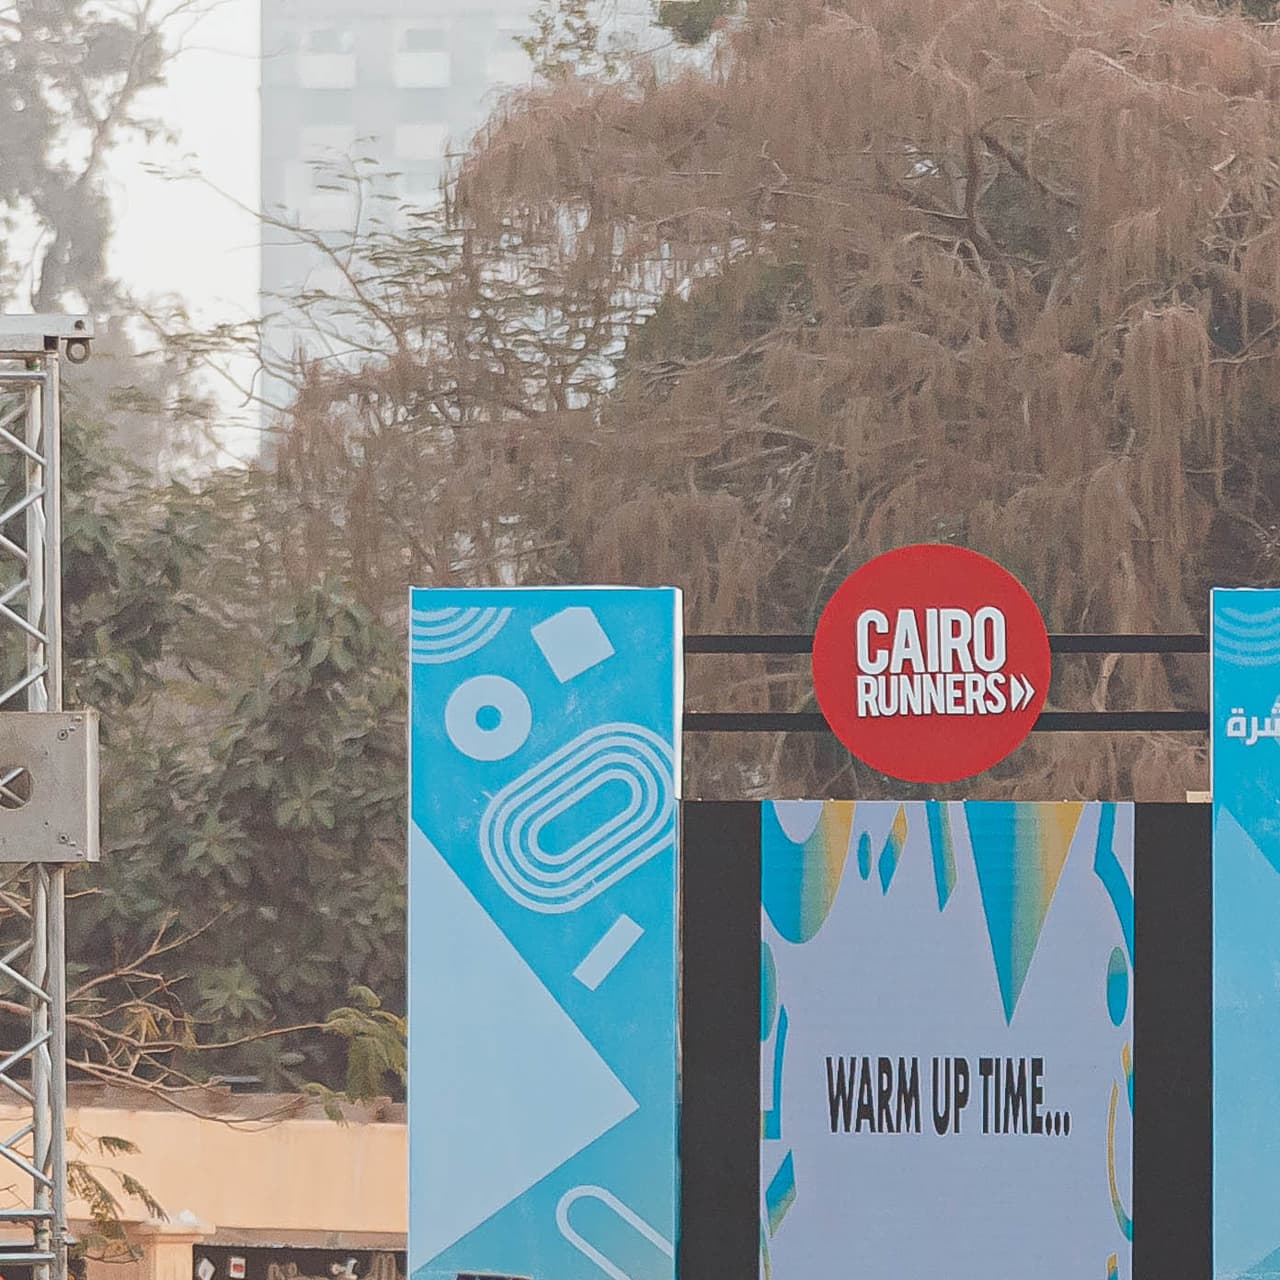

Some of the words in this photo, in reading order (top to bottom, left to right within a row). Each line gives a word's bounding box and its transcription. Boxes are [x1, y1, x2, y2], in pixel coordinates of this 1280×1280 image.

[857, 606, 1006, 675] CAIRO
[857, 672, 1007, 717] RUNNERS
[826, 1057, 921, 1134] WARM
[932, 1057, 970, 1135] UP
[979, 1057, 1072, 1136] TIME...
